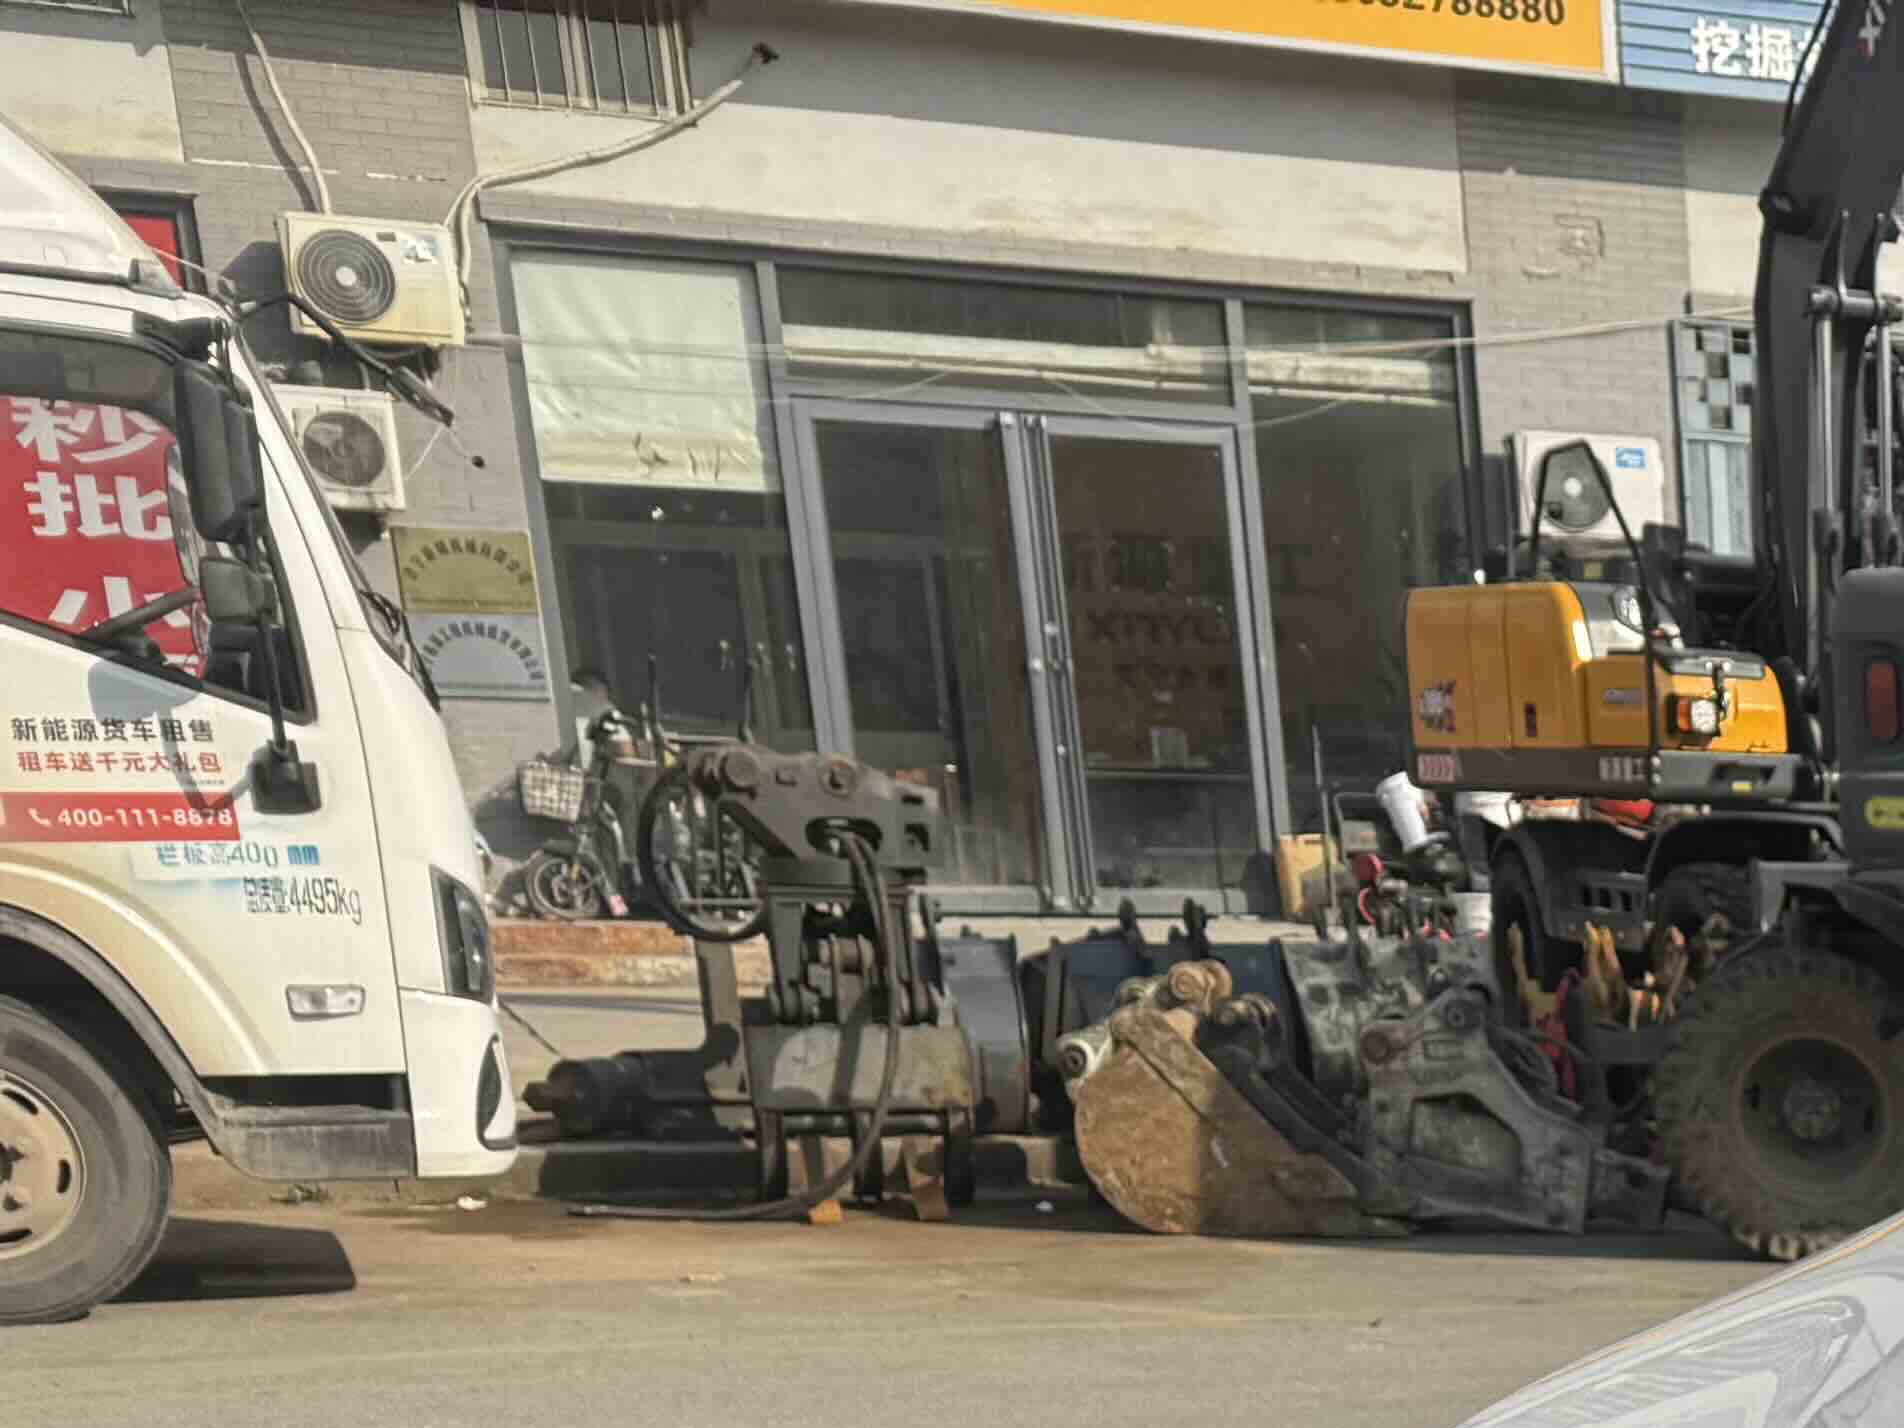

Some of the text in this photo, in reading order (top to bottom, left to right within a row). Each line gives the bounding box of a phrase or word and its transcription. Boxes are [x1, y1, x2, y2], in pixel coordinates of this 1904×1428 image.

[1691, 17, 1822, 88] 挖掘
[11, 717, 214, 742] 新能源货车租售
[18, 751, 223, 773] 租车送千元大礼包
[57, 807, 233, 828] 400-111-8878
